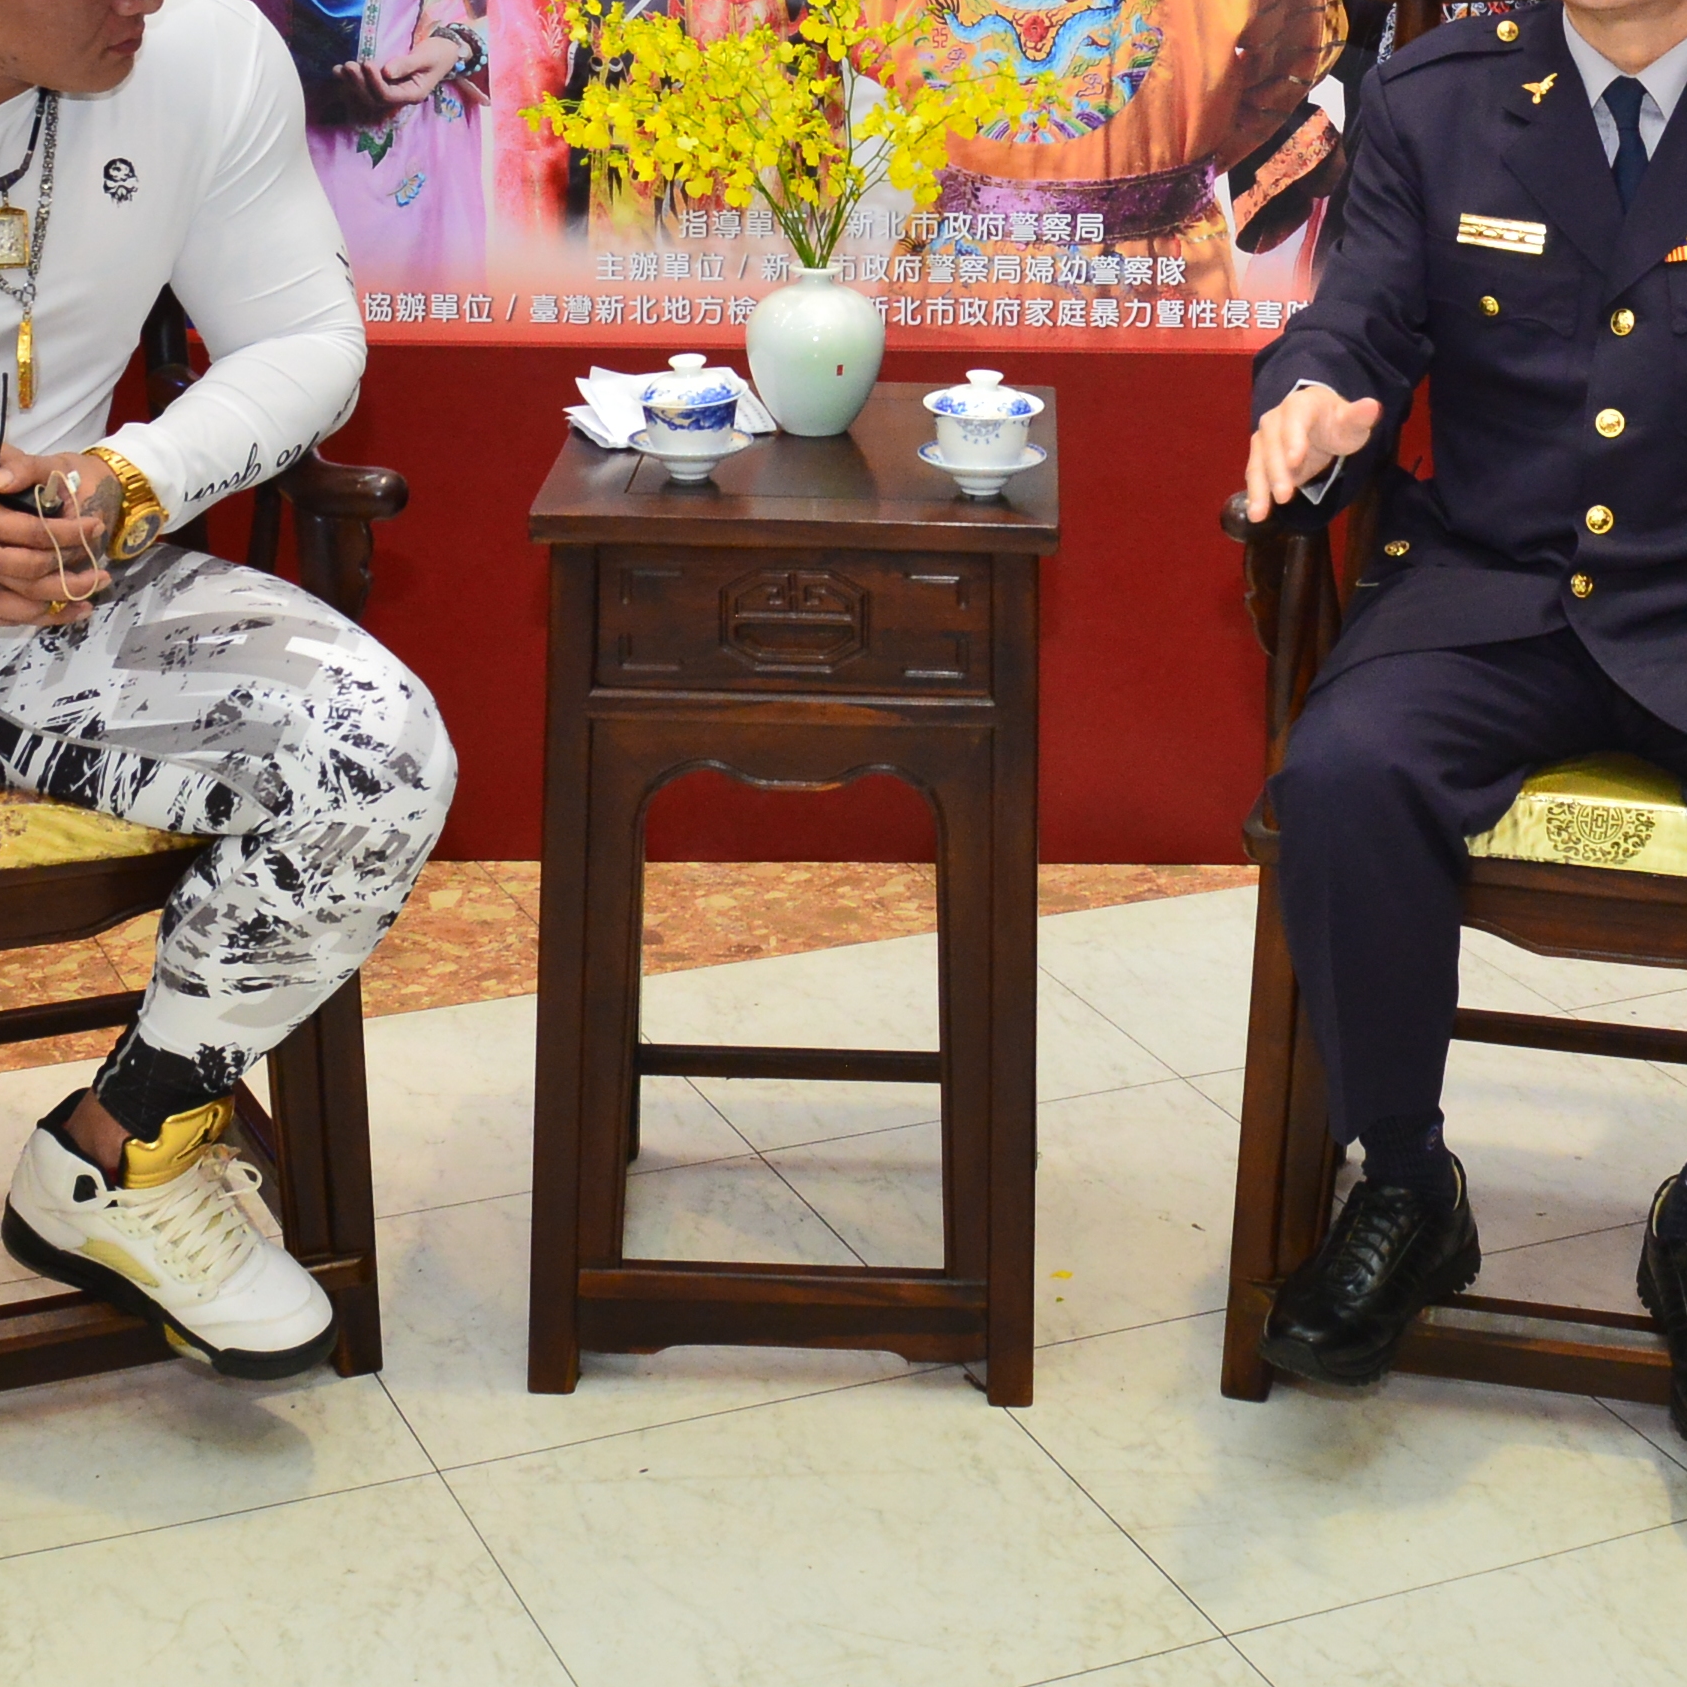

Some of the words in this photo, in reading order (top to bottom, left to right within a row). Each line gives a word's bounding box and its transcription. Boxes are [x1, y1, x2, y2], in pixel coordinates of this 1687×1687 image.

[761, 252, 1188, 286] 新市政府警察局婦幼警察隊
